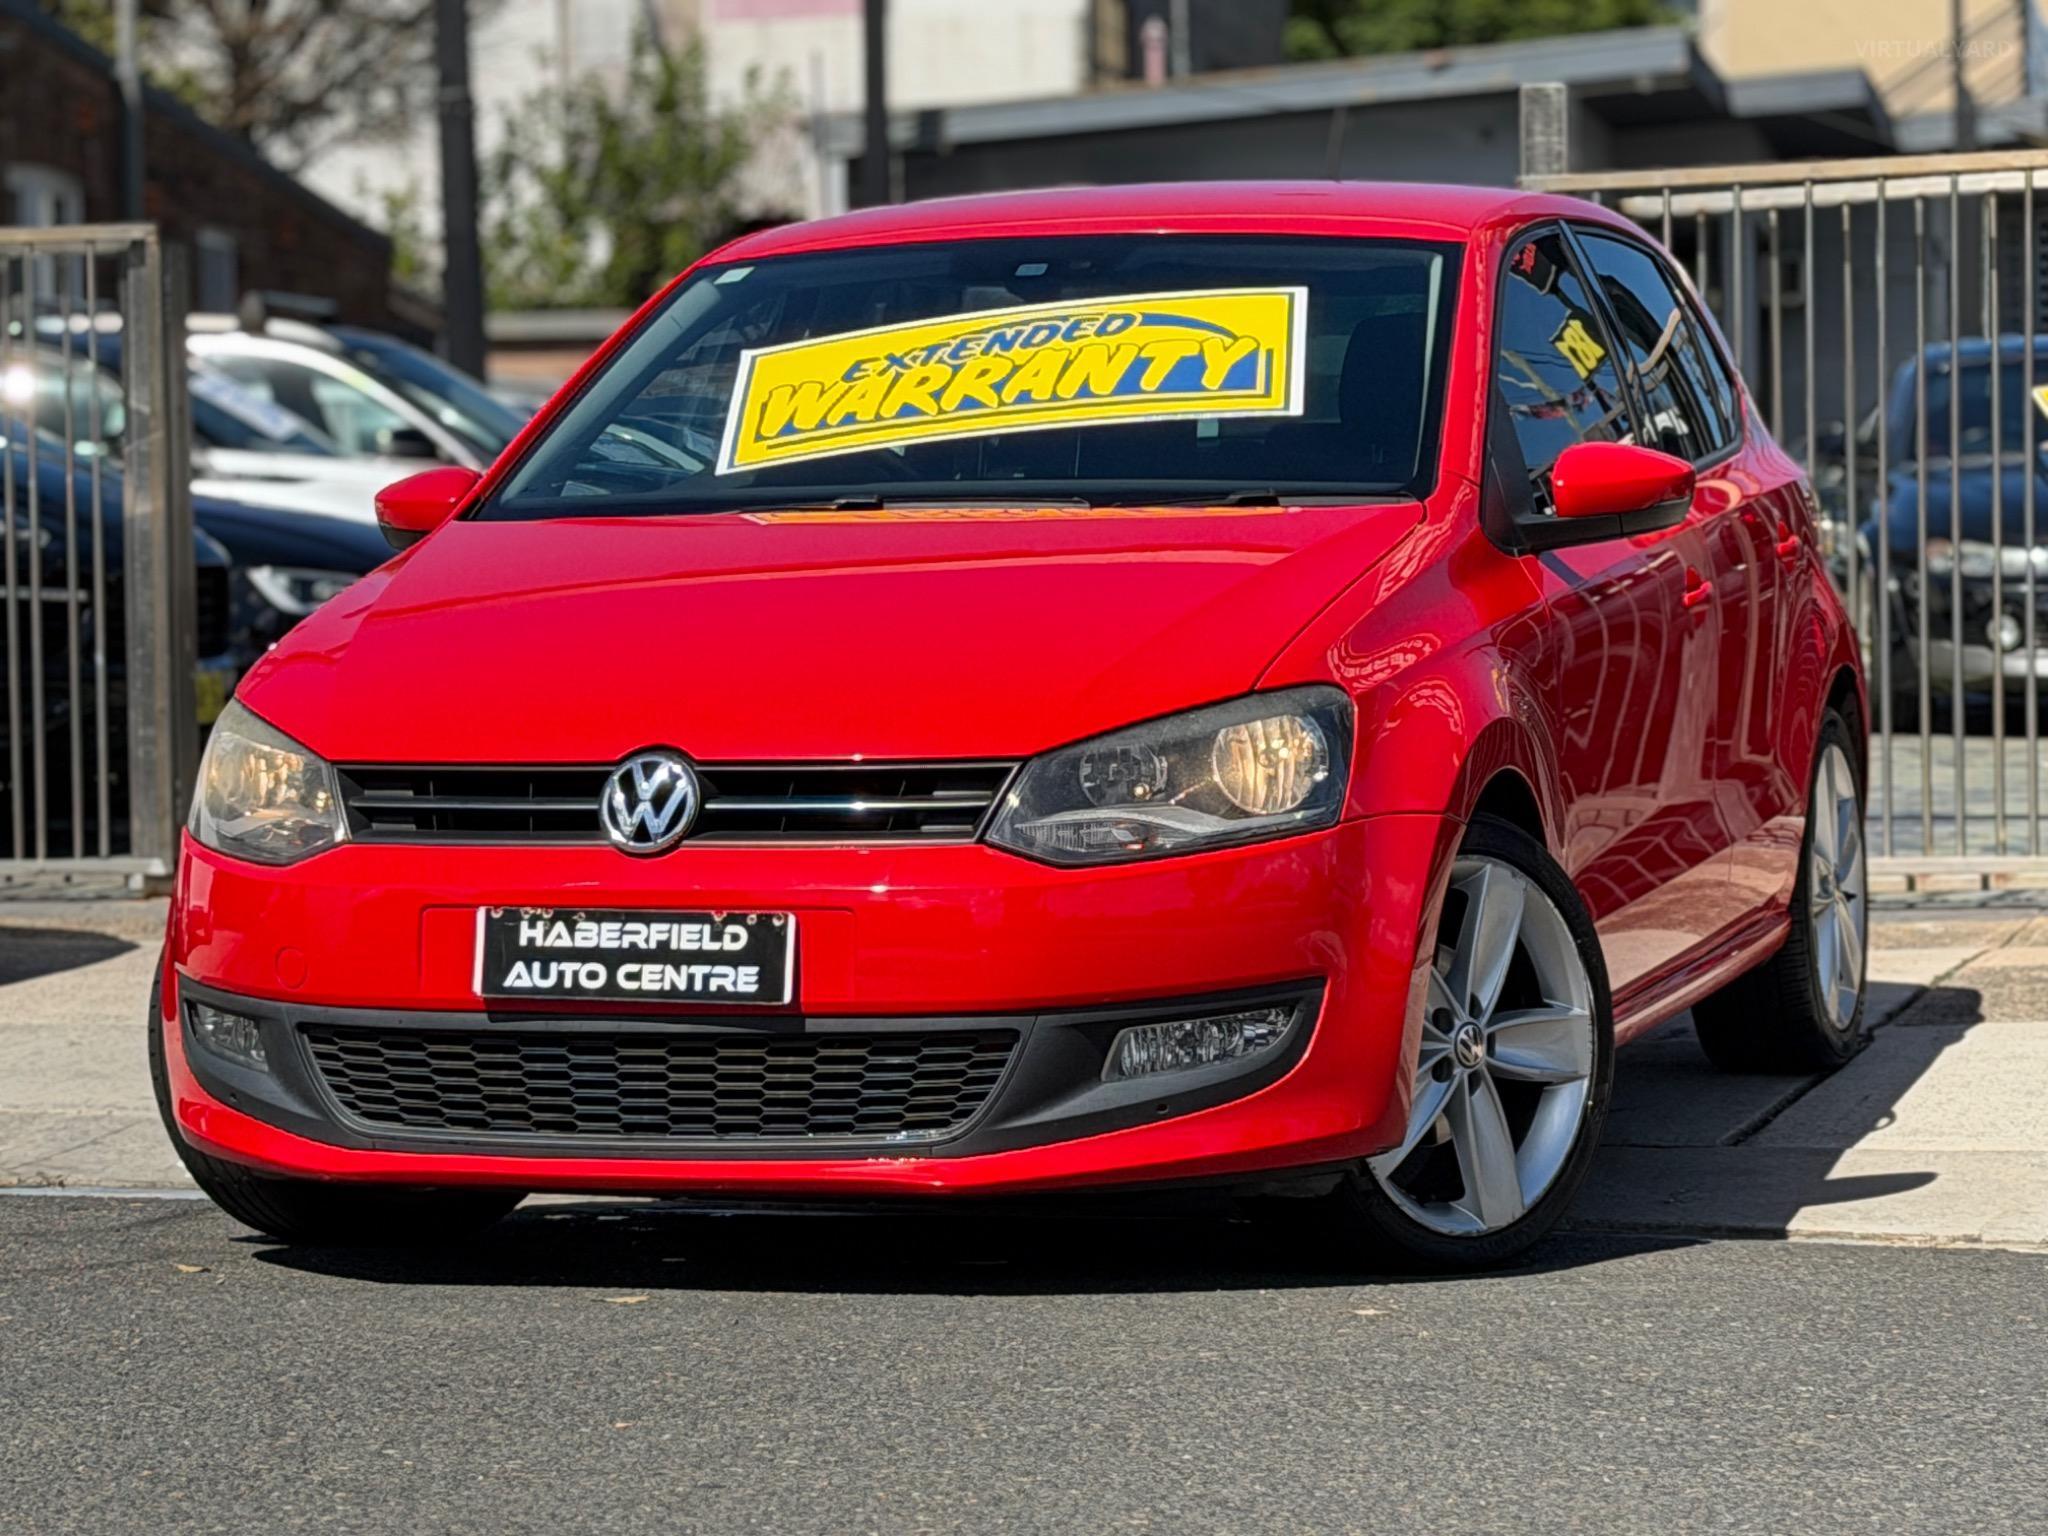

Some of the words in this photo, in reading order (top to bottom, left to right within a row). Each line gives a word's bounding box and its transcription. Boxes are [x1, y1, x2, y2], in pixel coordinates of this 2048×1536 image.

[841, 312, 1139, 384] EXTENDED
[758, 335, 1260, 438] WARRANTY
[606, 757, 693, 843] VW
[518, 920, 749, 951] HABERFIELD
[503, 960, 608, 989] AUTO
[616, 963, 760, 993] CENTRE
